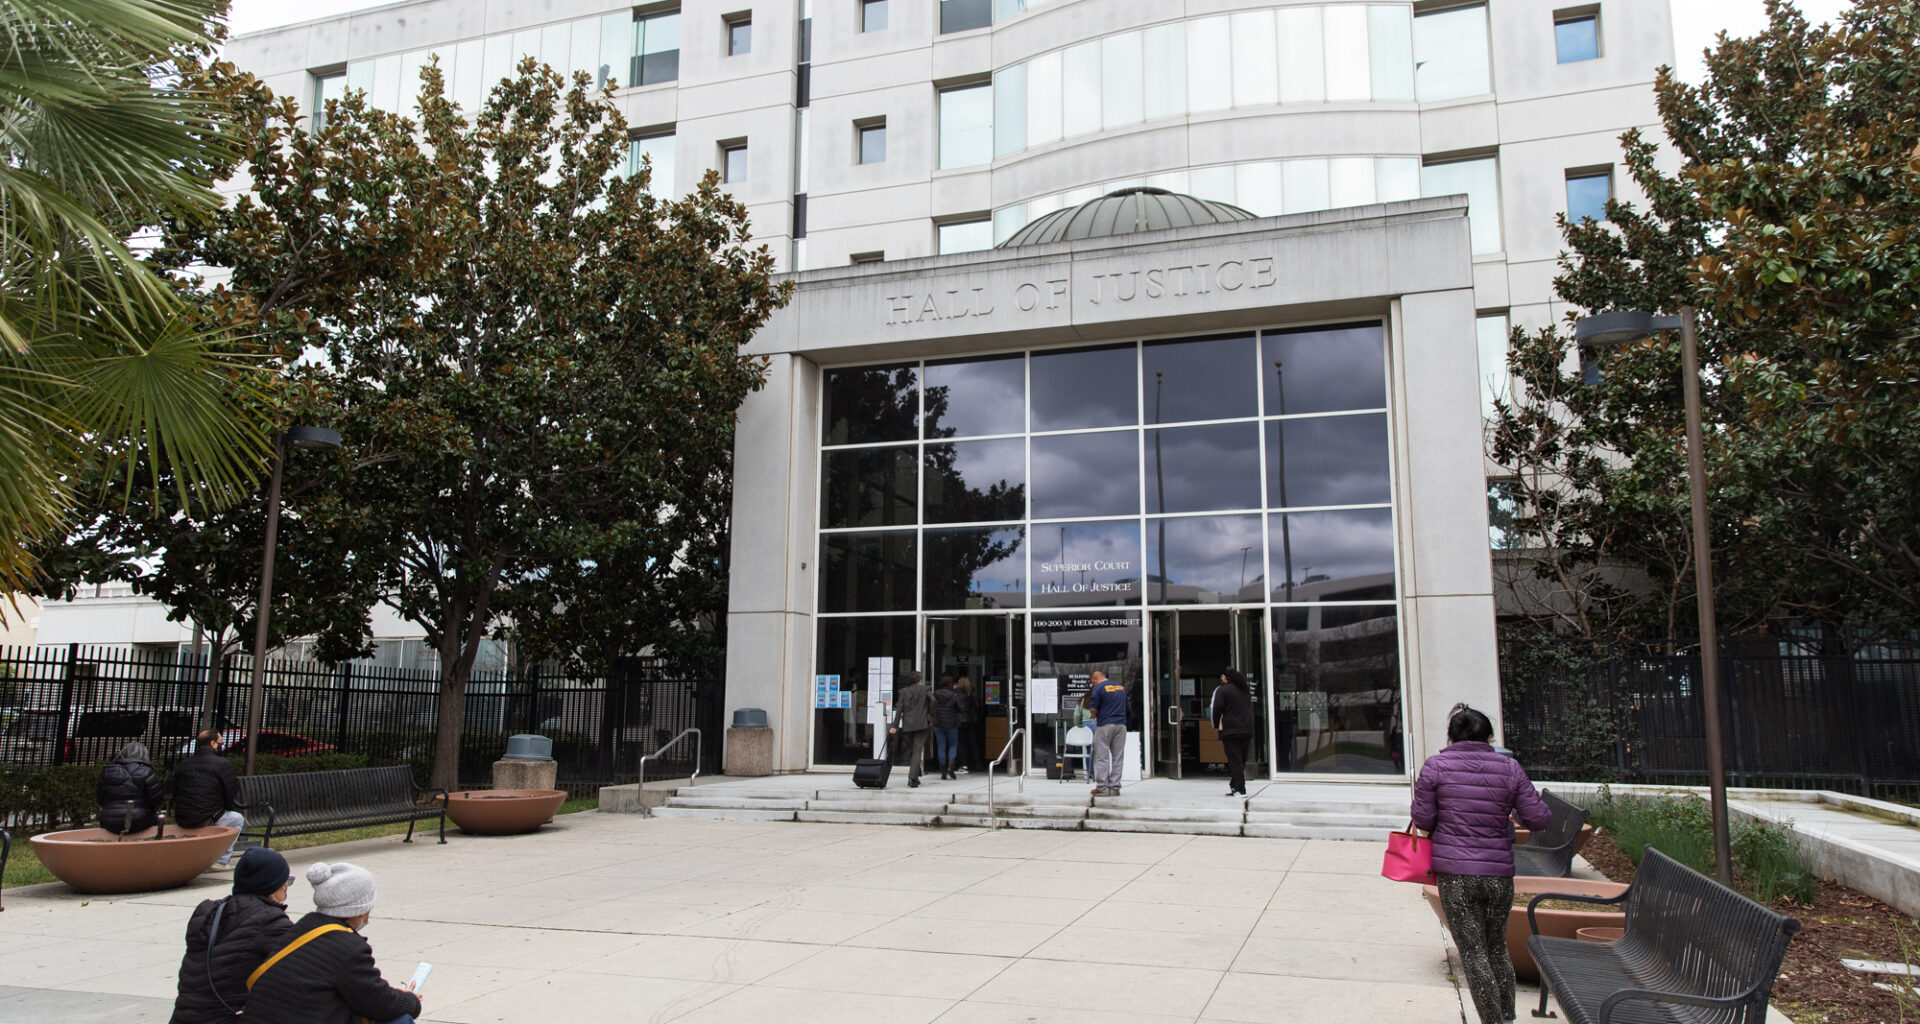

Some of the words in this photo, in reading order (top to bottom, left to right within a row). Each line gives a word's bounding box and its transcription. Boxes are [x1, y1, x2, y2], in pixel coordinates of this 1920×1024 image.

[885, 287, 995, 327] HALL
[1013, 278, 1069, 313] OF
[1089, 256, 1278, 306] JUSTICE
[1041, 562, 1091, 572] SUPERIOR
[1094, 560, 1131, 571] COURT
[1041, 583, 1070, 594] HALL
[1090, 582, 1132, 592] JUSTICE
[1109, 618, 1140, 626] STREET
